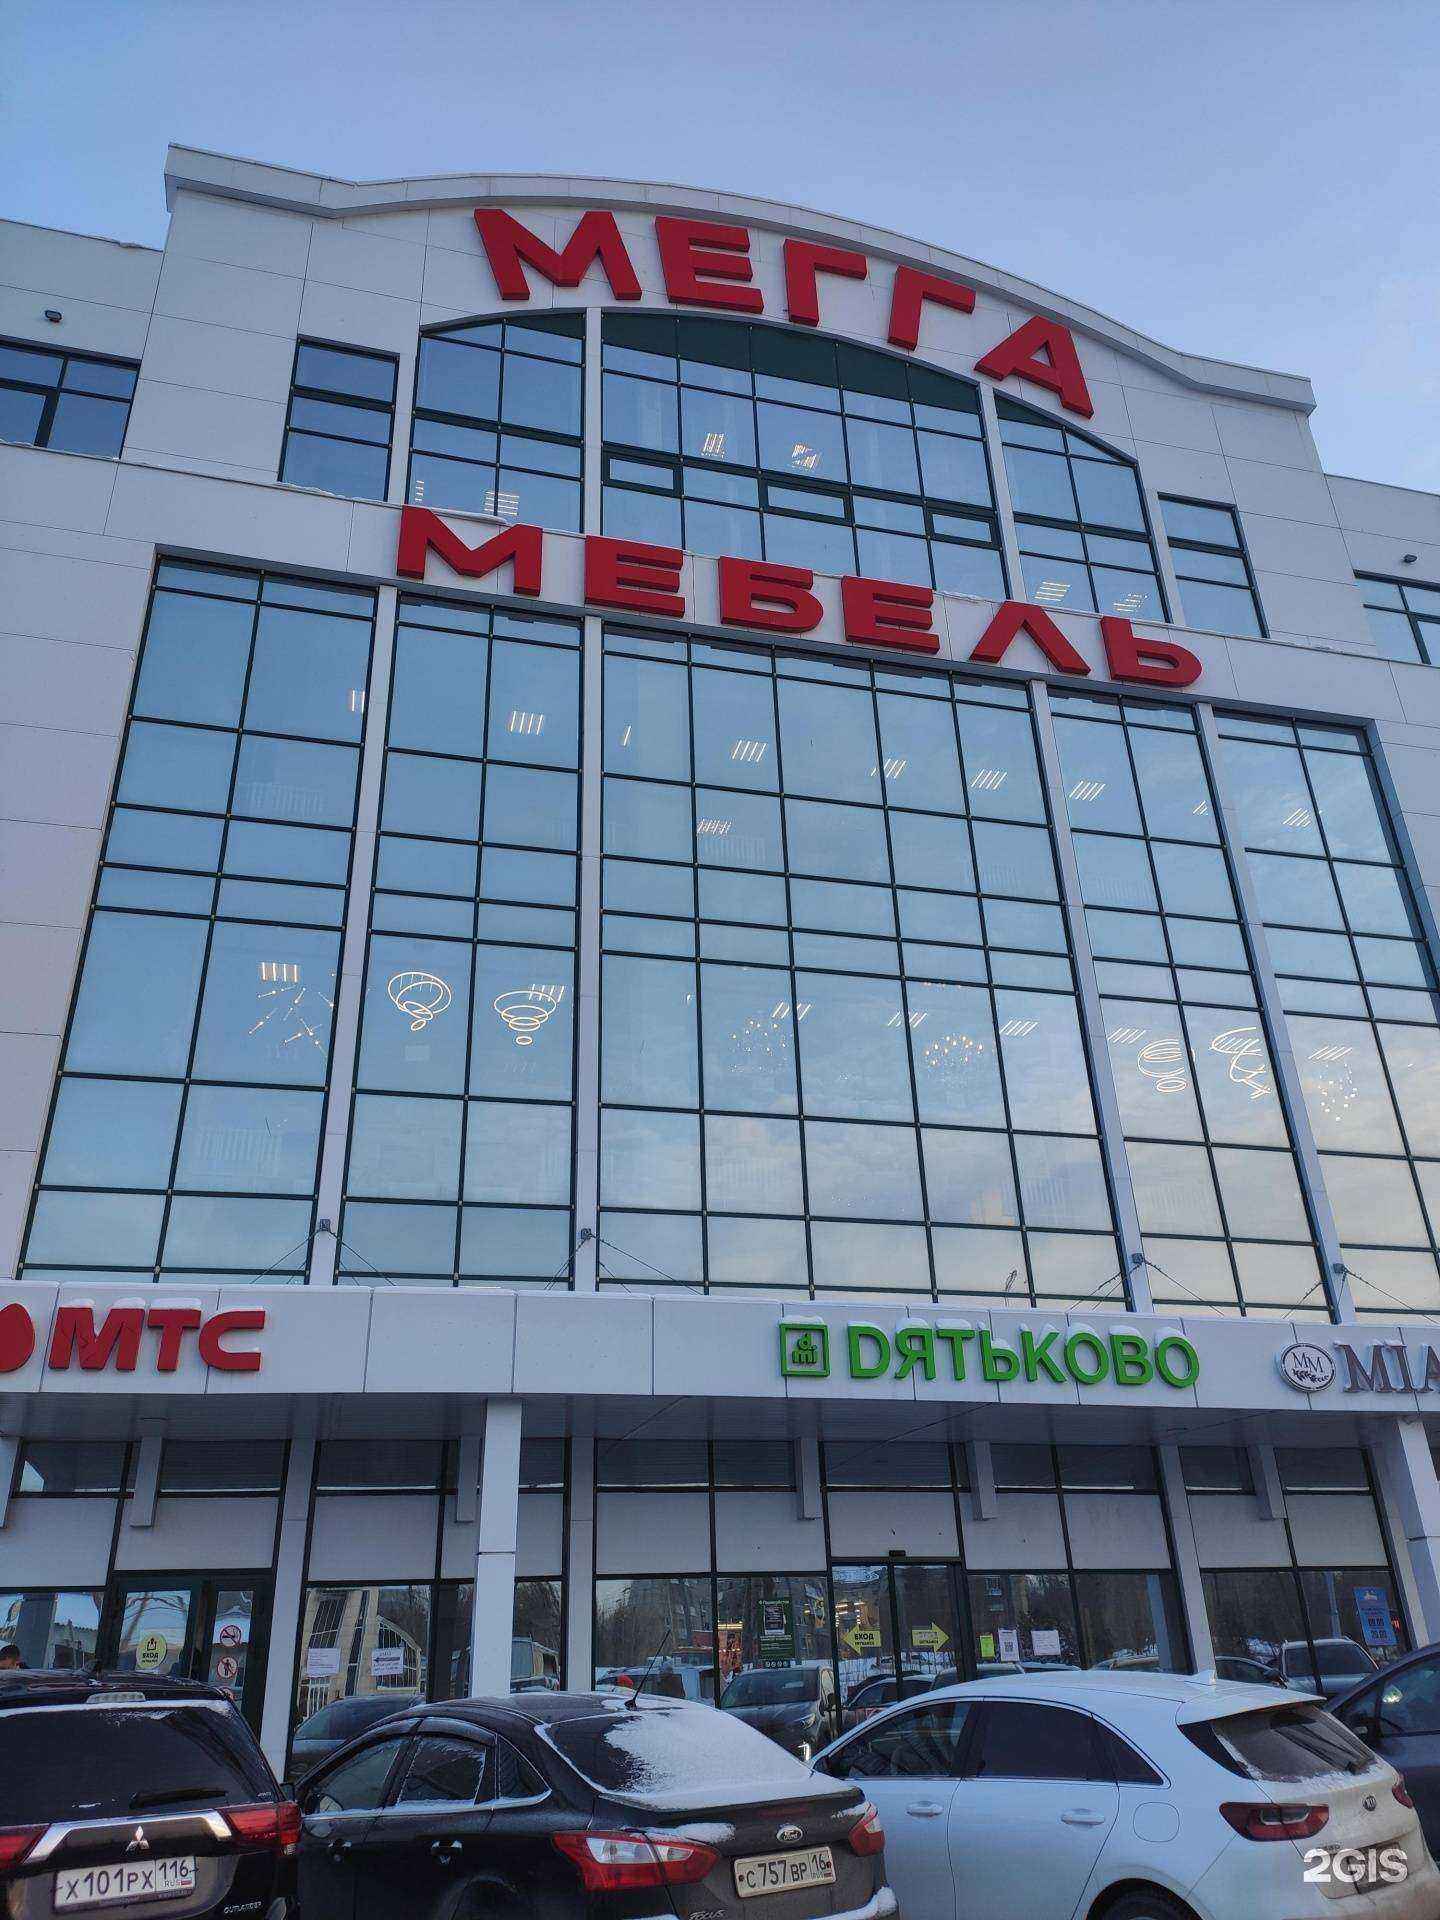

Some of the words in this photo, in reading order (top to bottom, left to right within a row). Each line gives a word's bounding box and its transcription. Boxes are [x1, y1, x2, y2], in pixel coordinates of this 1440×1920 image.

[474, 207, 1094, 418] МЕГГА
[396, 505, 1202, 688] МЕБЕЛЬ
[48, 1306, 266, 1371] МТС
[159, 1859, 188, 1880] 116
